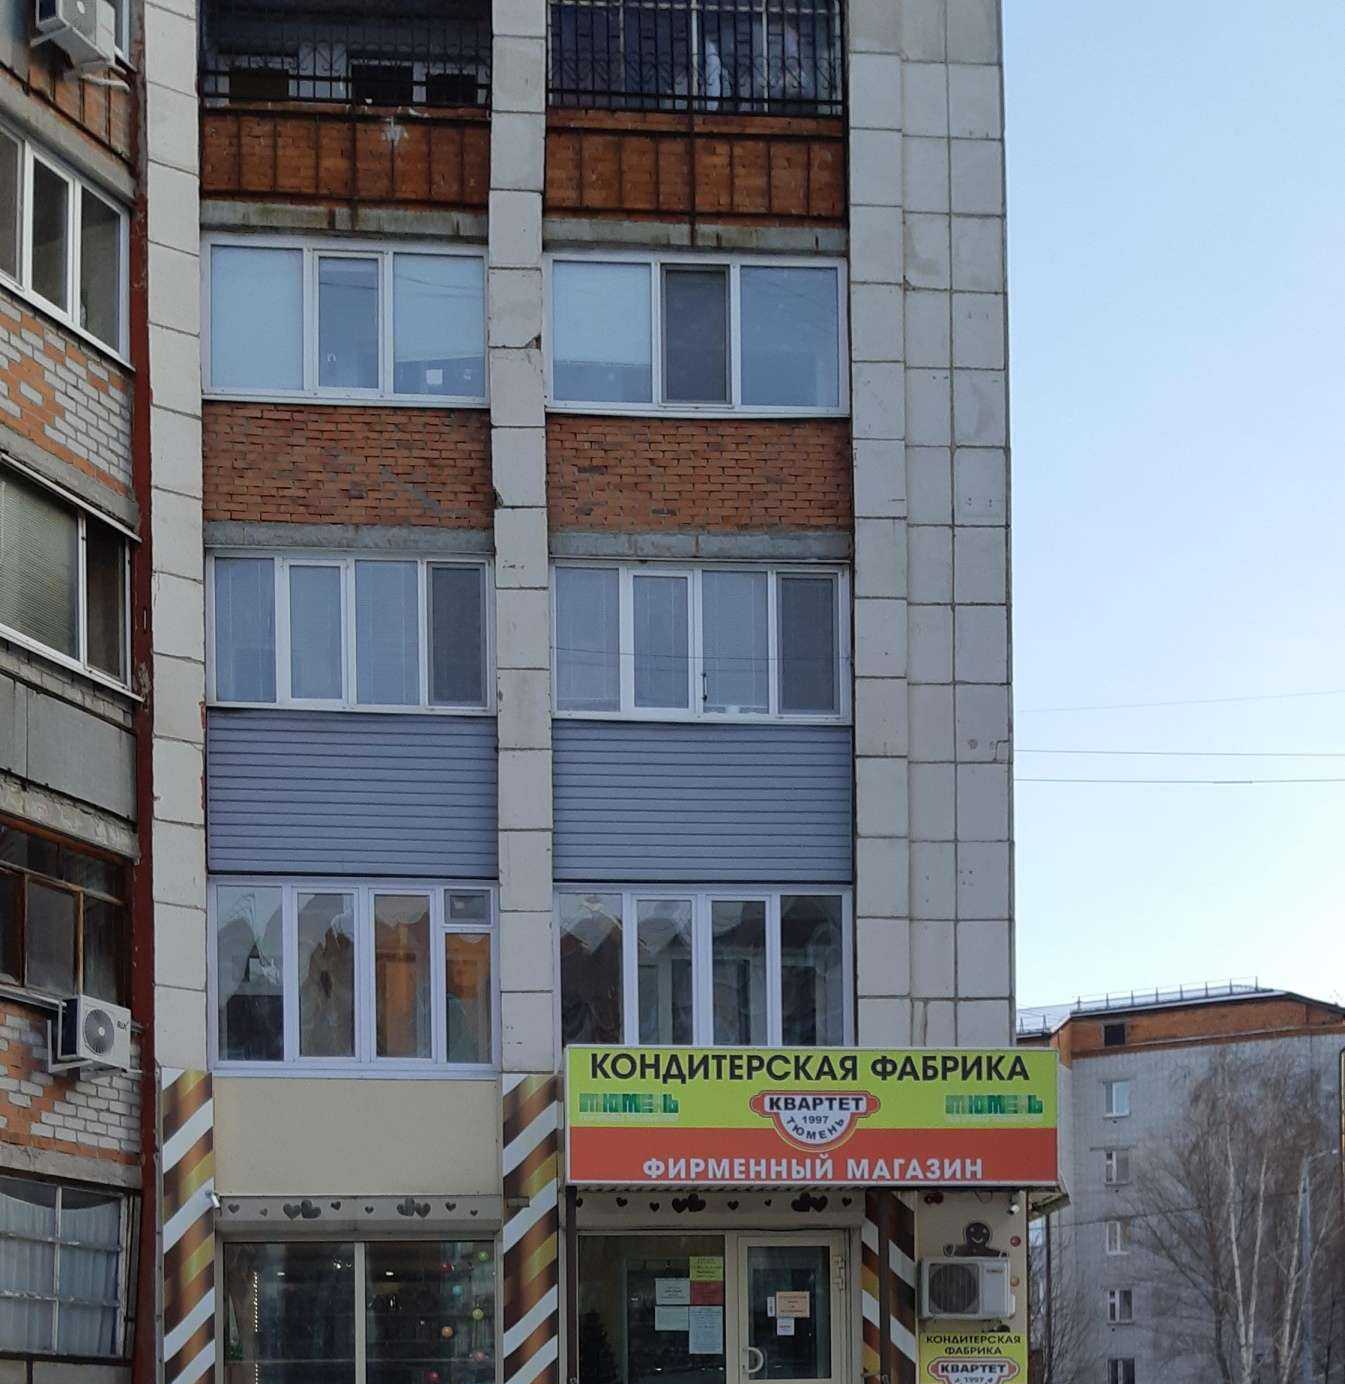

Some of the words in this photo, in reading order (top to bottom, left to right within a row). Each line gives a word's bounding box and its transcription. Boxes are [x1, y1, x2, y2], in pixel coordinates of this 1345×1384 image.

[590, 1053, 859, 1085] КОНДИТЕРСКАЯ
[870, 1054, 1030, 1082] ФАБРИКА
[768, 1096, 864, 1111] КВАРТЕТ
[802, 1115, 829, 1125] 1997
[786, 1116, 844, 1140] ТЮМЕНЬ
[643, 1153, 832, 1181] ФИРМЕННЫЙ
[846, 1158, 983, 1180] МАГАЗИН
[926, 1335, 1021, 1345] КОНДИТЕРСКАЯ
[944, 1346, 1002, 1355] ФАБРИКА
[940, 1363, 1006, 1373] КВАРТЕТ
